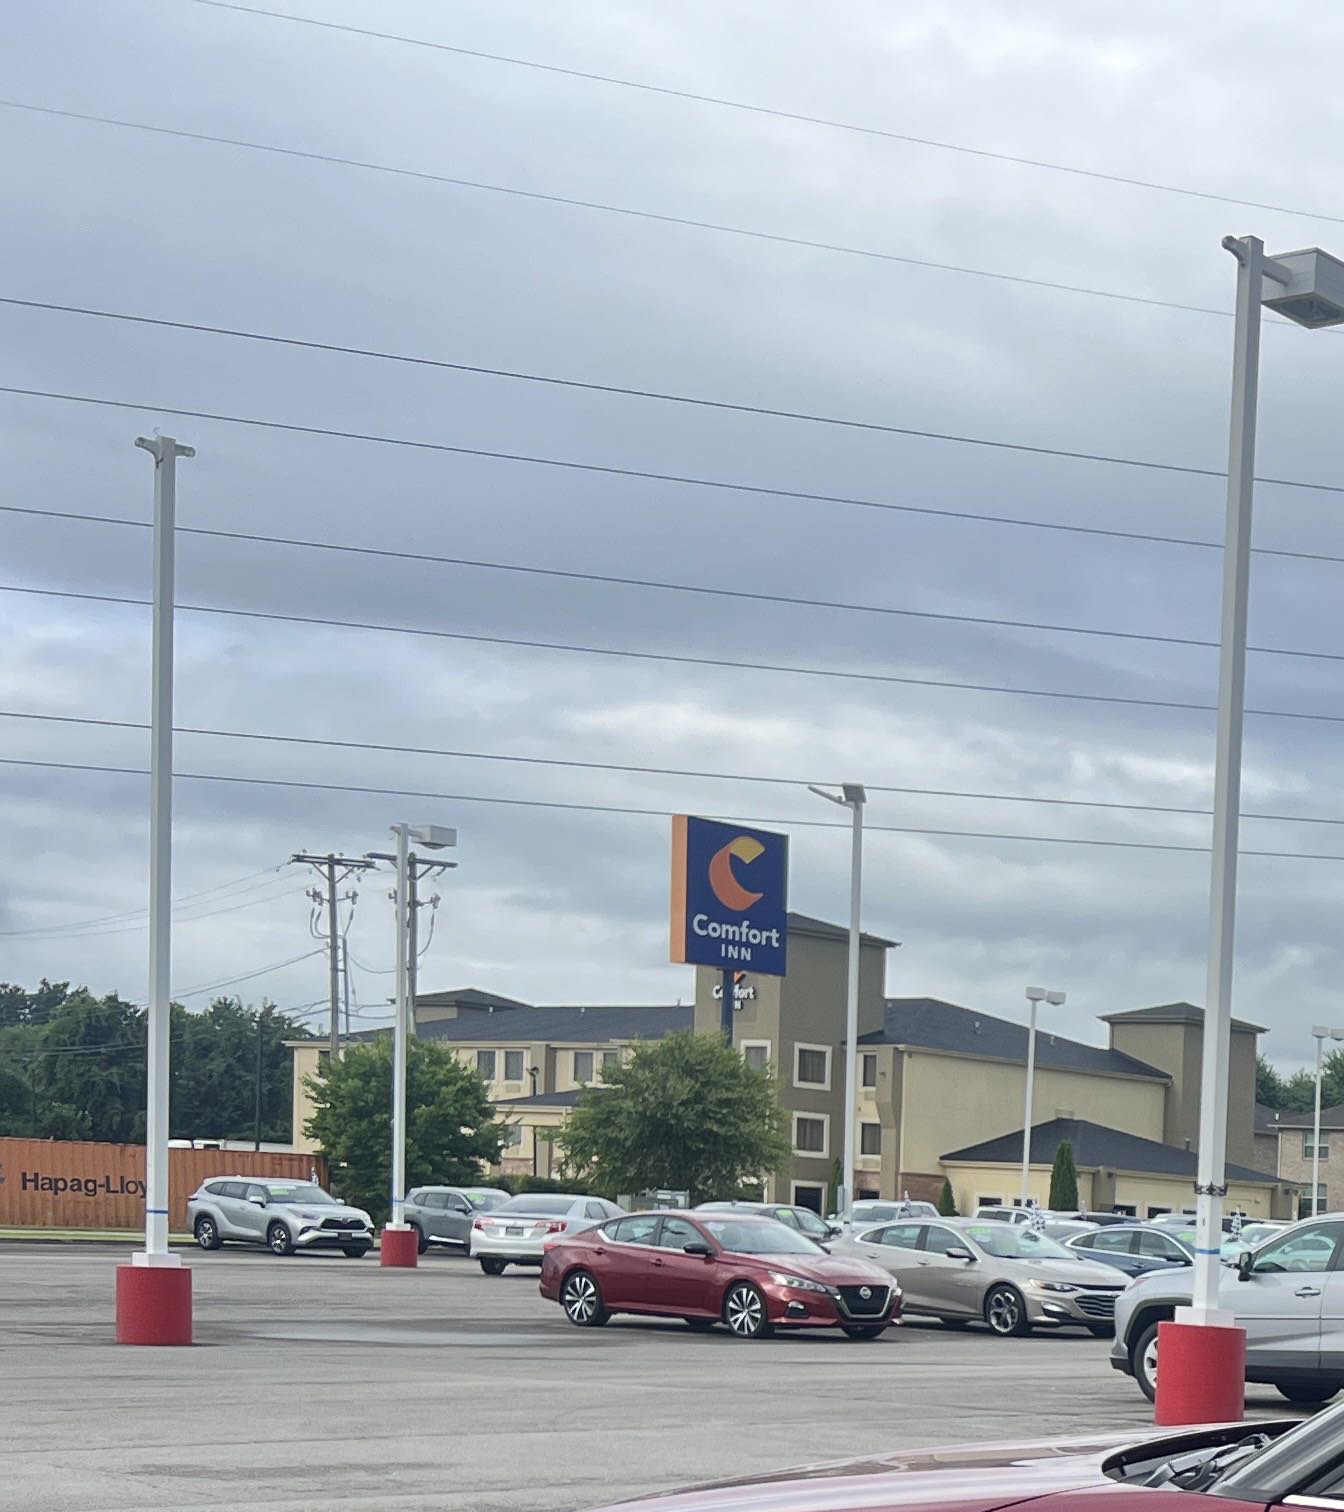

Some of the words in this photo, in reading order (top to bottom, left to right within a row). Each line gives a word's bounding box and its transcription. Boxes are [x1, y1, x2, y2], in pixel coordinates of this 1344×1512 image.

[692, 913, 780, 948] Comfort
[721, 943, 752, 961] INN
[21, 1171, 147, 1199] Hapag-Lloy
